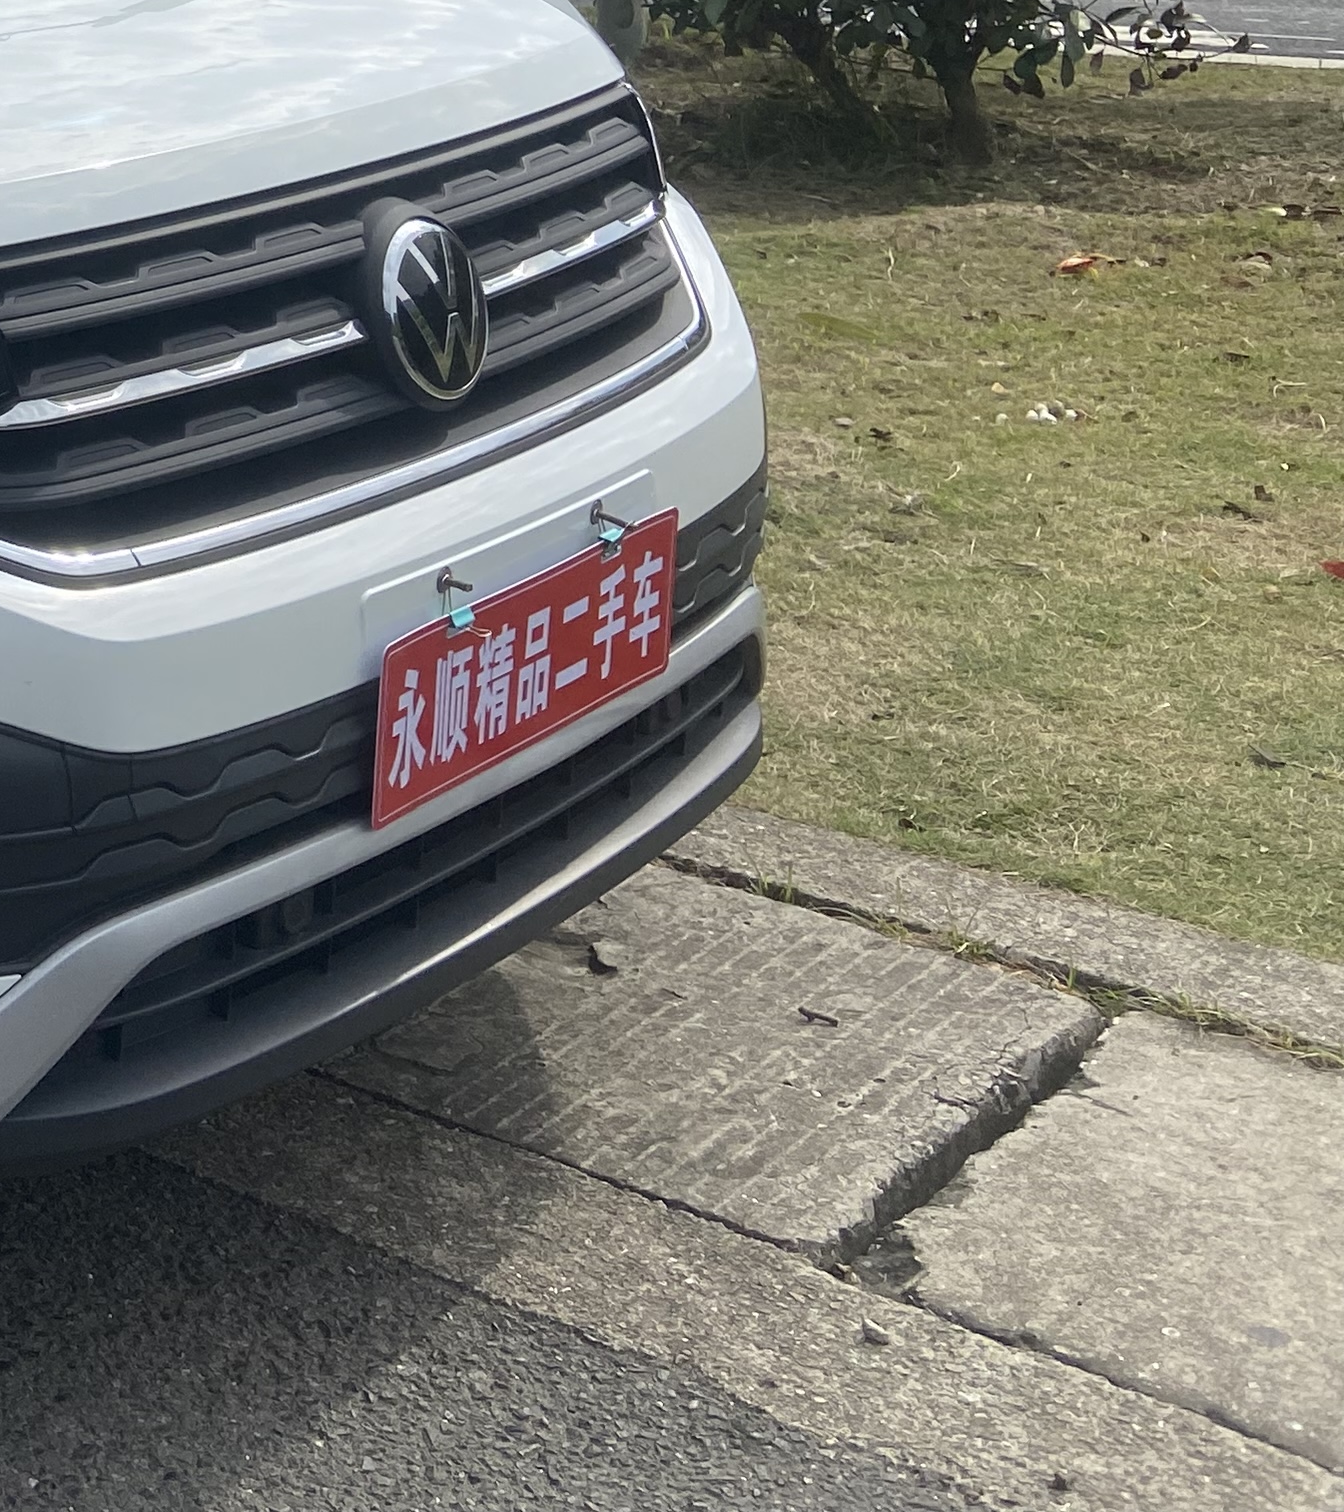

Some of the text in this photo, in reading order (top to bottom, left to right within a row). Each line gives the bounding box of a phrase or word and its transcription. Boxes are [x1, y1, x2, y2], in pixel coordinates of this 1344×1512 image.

[387, 550, 664, 789] 永顺精品二手车
